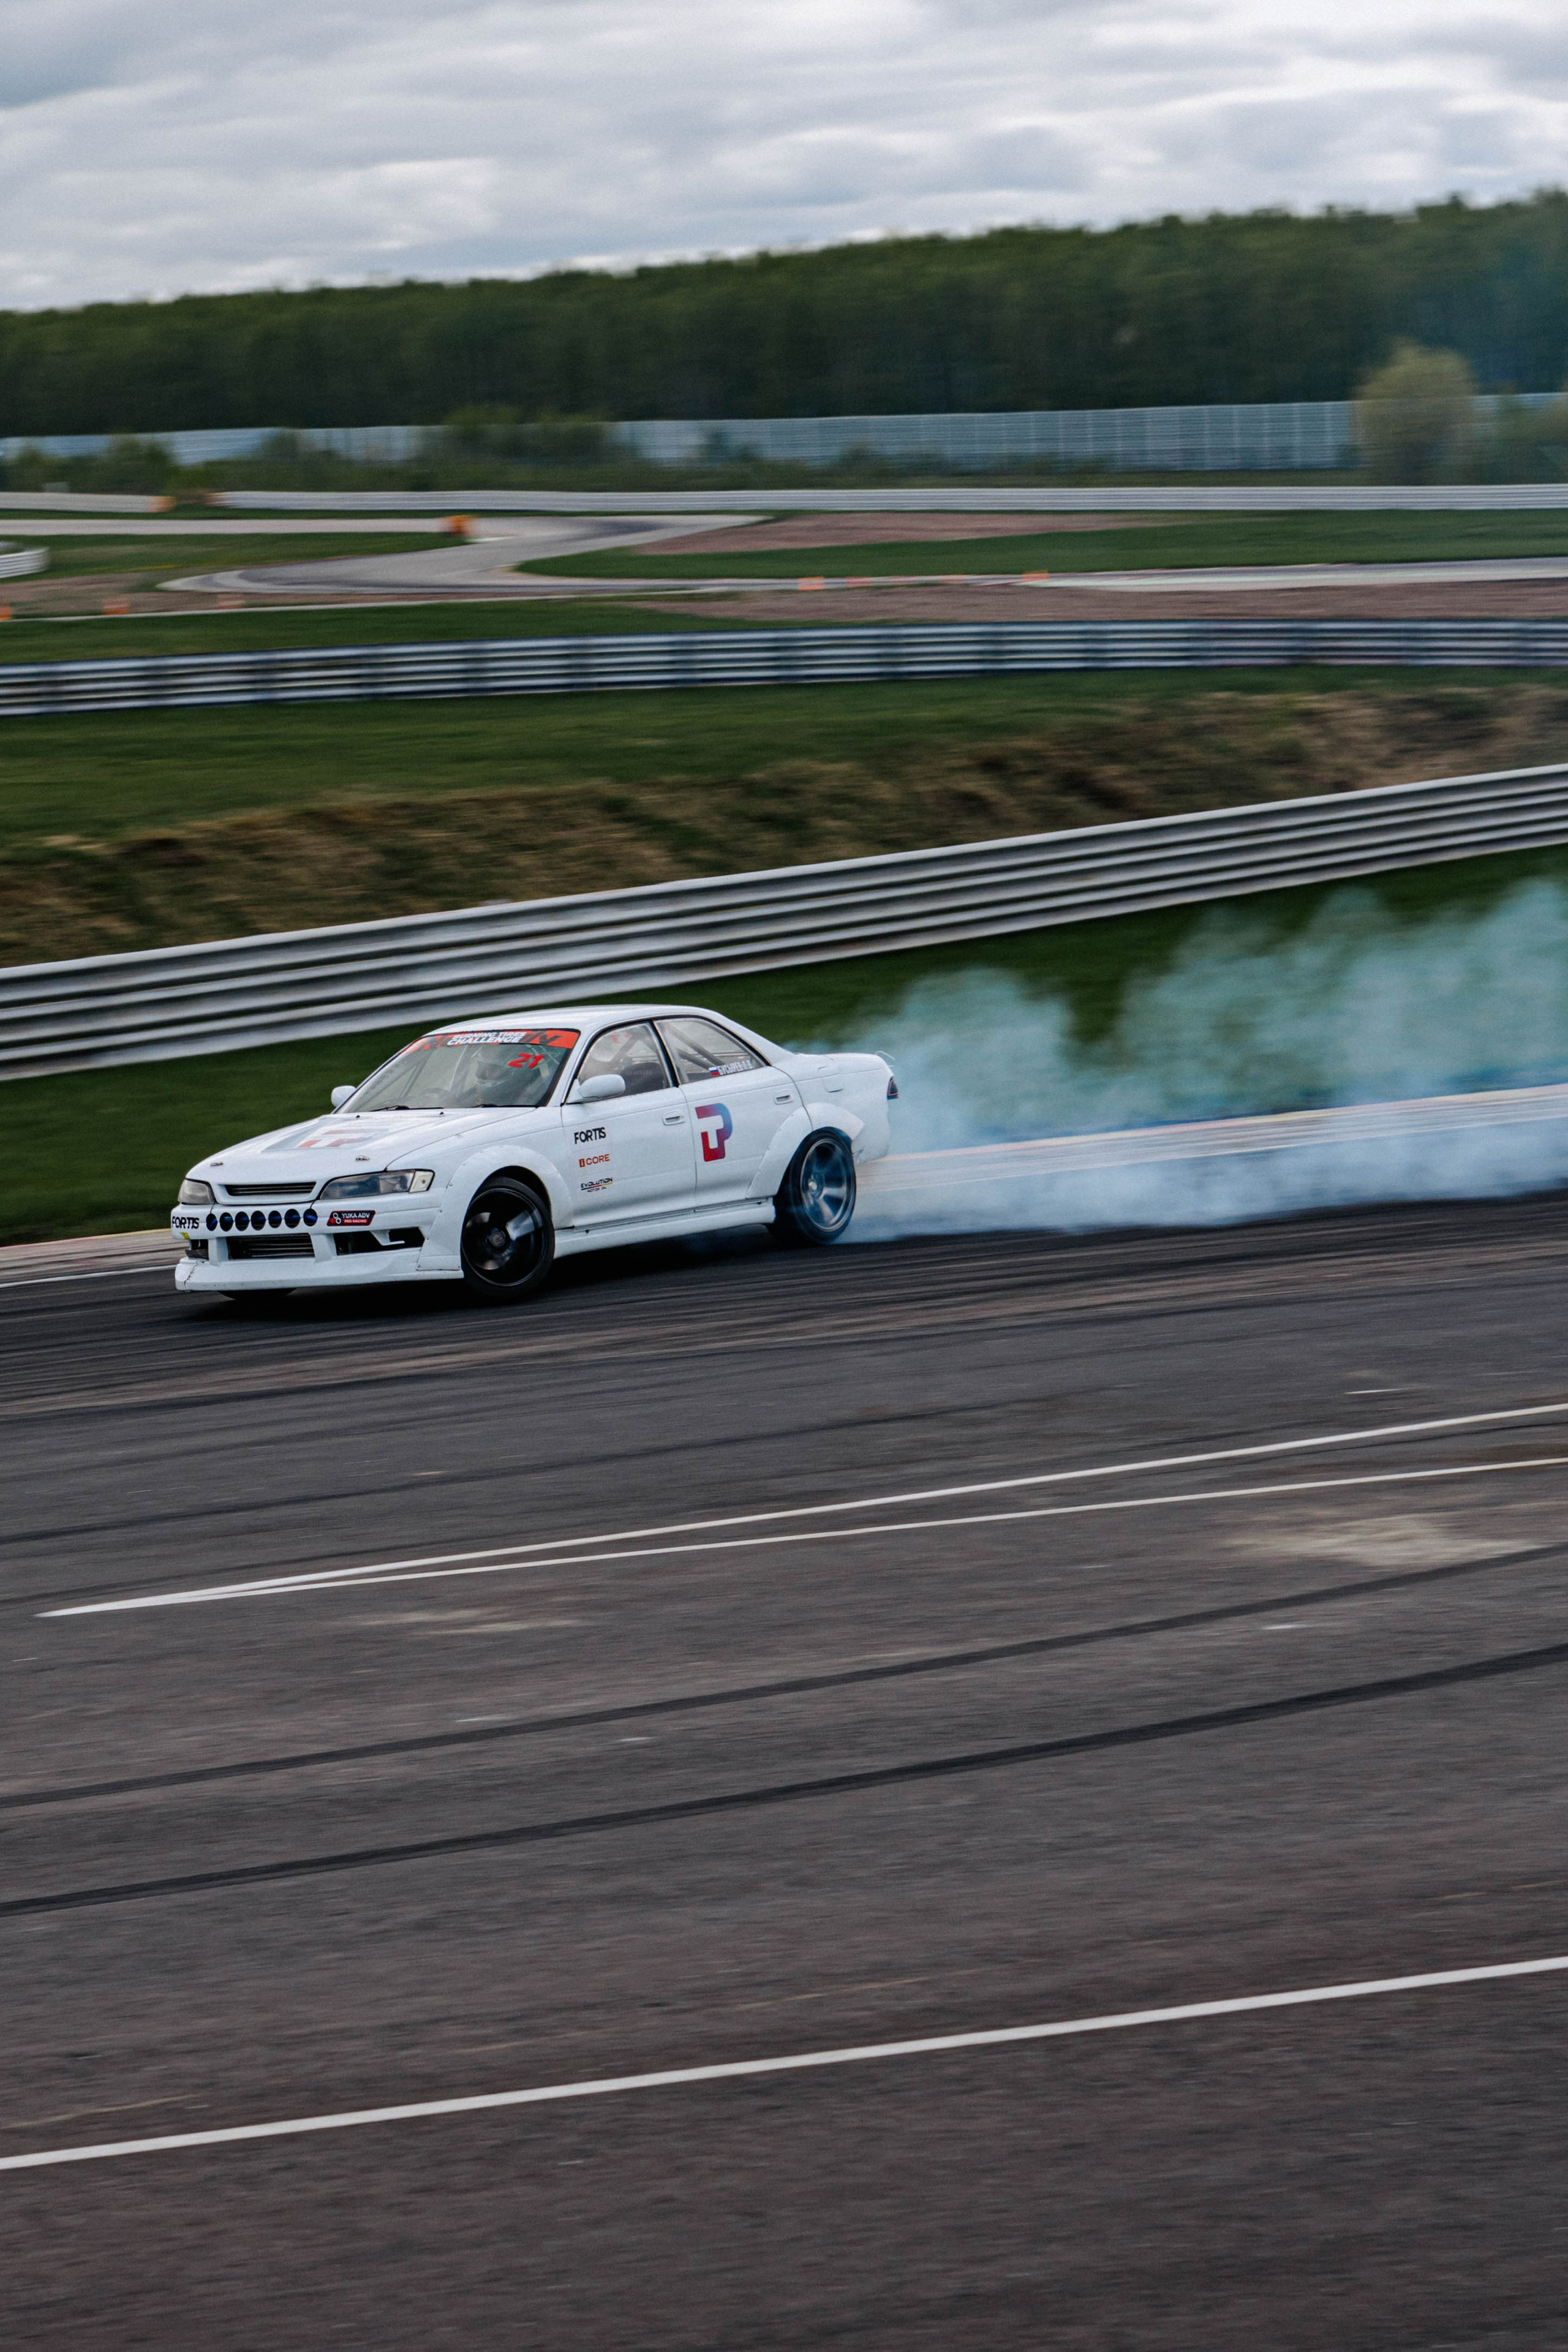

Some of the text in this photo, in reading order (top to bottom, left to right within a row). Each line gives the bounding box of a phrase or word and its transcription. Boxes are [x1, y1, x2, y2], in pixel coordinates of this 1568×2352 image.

[447, 1036, 522, 1046] CHALLENGE
[507, 1052, 545, 1069] 21
[574, 1126, 606, 1145] FORTIS
[580, 1177, 613, 1188] EVOLUTION
[172, 1216, 200, 1229] FORTIS
